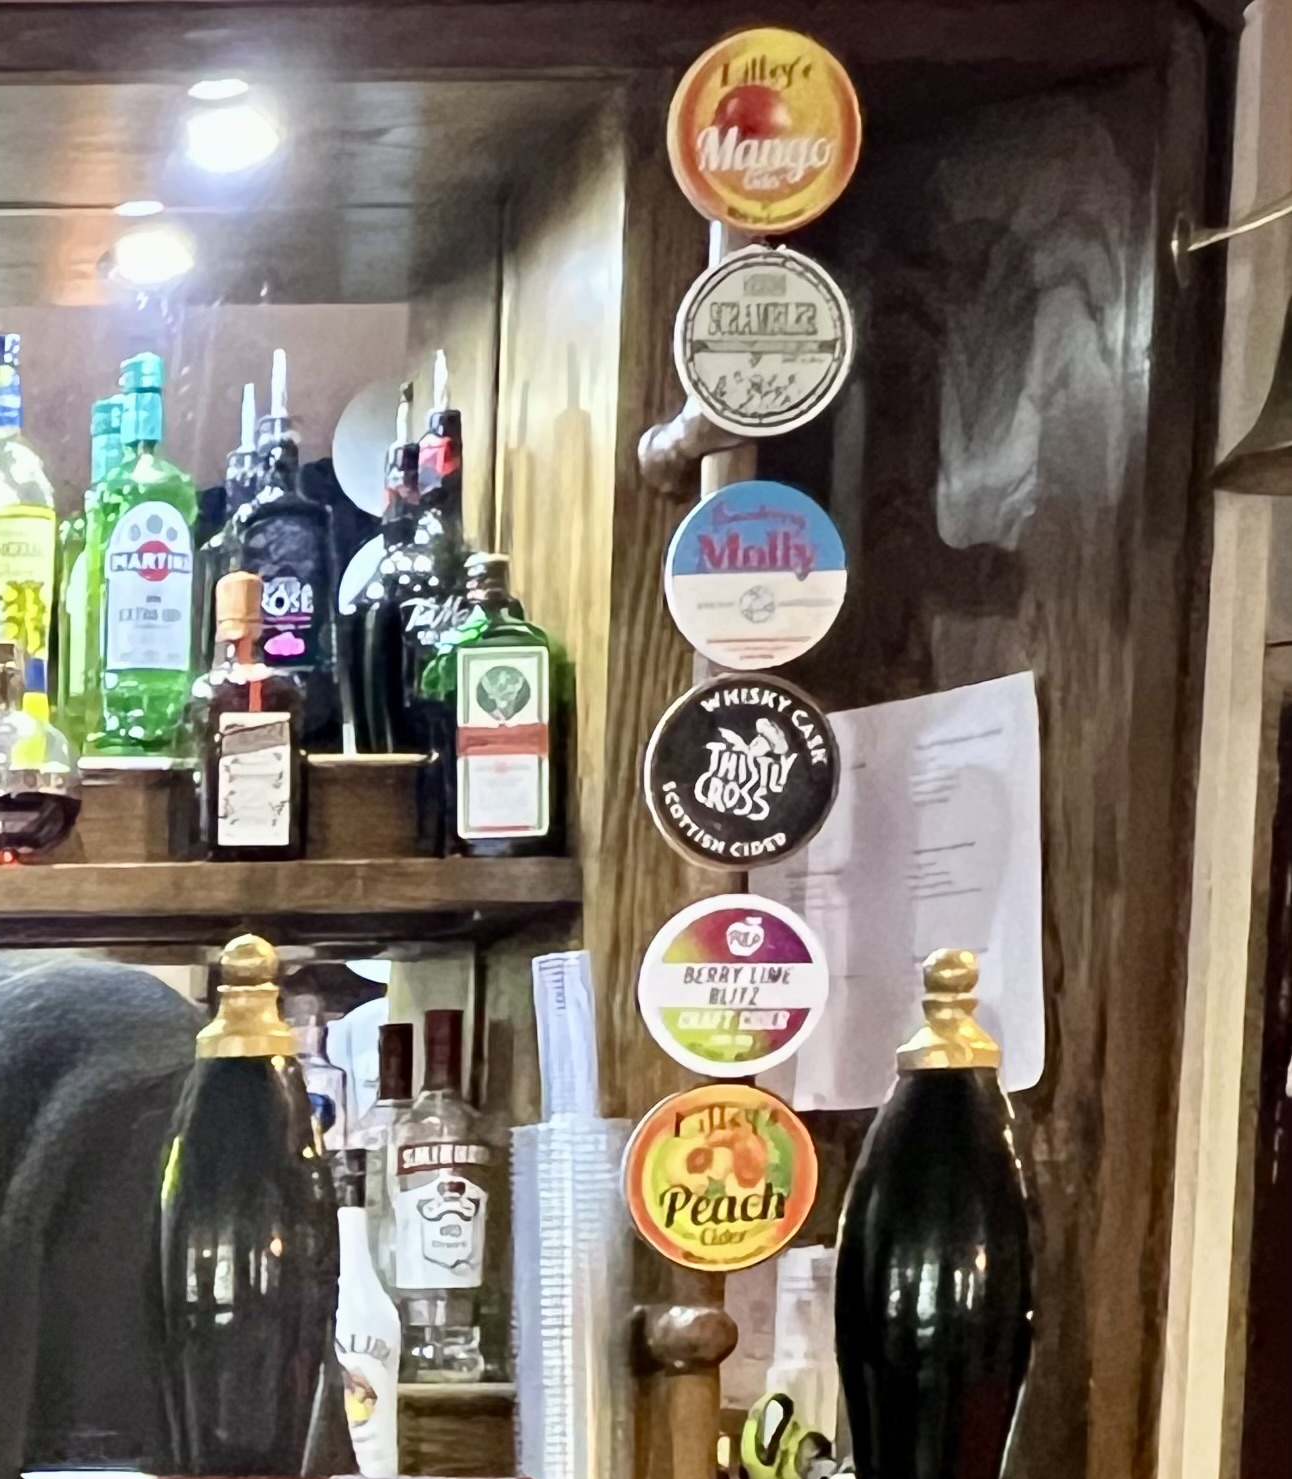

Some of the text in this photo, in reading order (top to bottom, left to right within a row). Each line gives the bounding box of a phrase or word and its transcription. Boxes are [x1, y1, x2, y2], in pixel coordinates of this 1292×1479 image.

[696, 125, 834, 184] Mango
[701, 687, 829, 766] WHISKY CASK
[705, 742, 798, 793] THISTLY
[694, 770, 771, 821] CROSS
[683, 965, 744, 985] BERRY
[708, 986, 761, 1006] BLITZ
[659, 1182, 786, 1228] Peach
